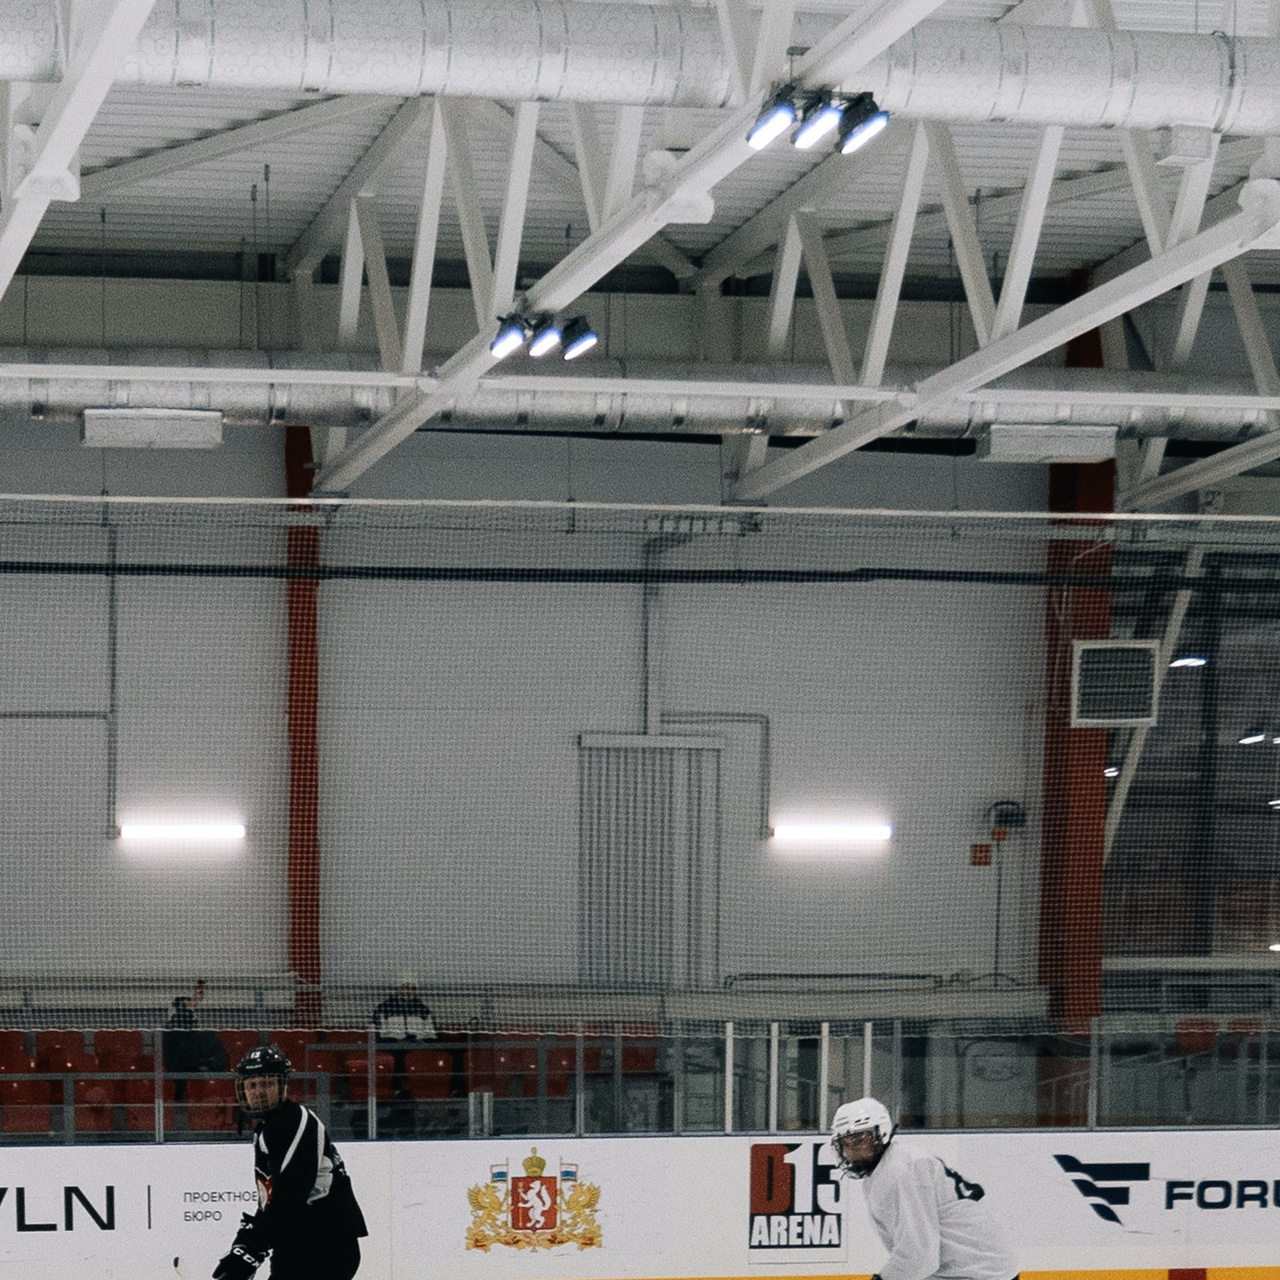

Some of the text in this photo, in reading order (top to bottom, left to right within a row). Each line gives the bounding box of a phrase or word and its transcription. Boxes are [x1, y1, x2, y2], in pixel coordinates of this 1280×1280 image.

[1165, 1180, 1280, 1210] FOR
[183, 1210, 222, 1222] БЮРО
[750, 1215, 840, 1246] ARENA
